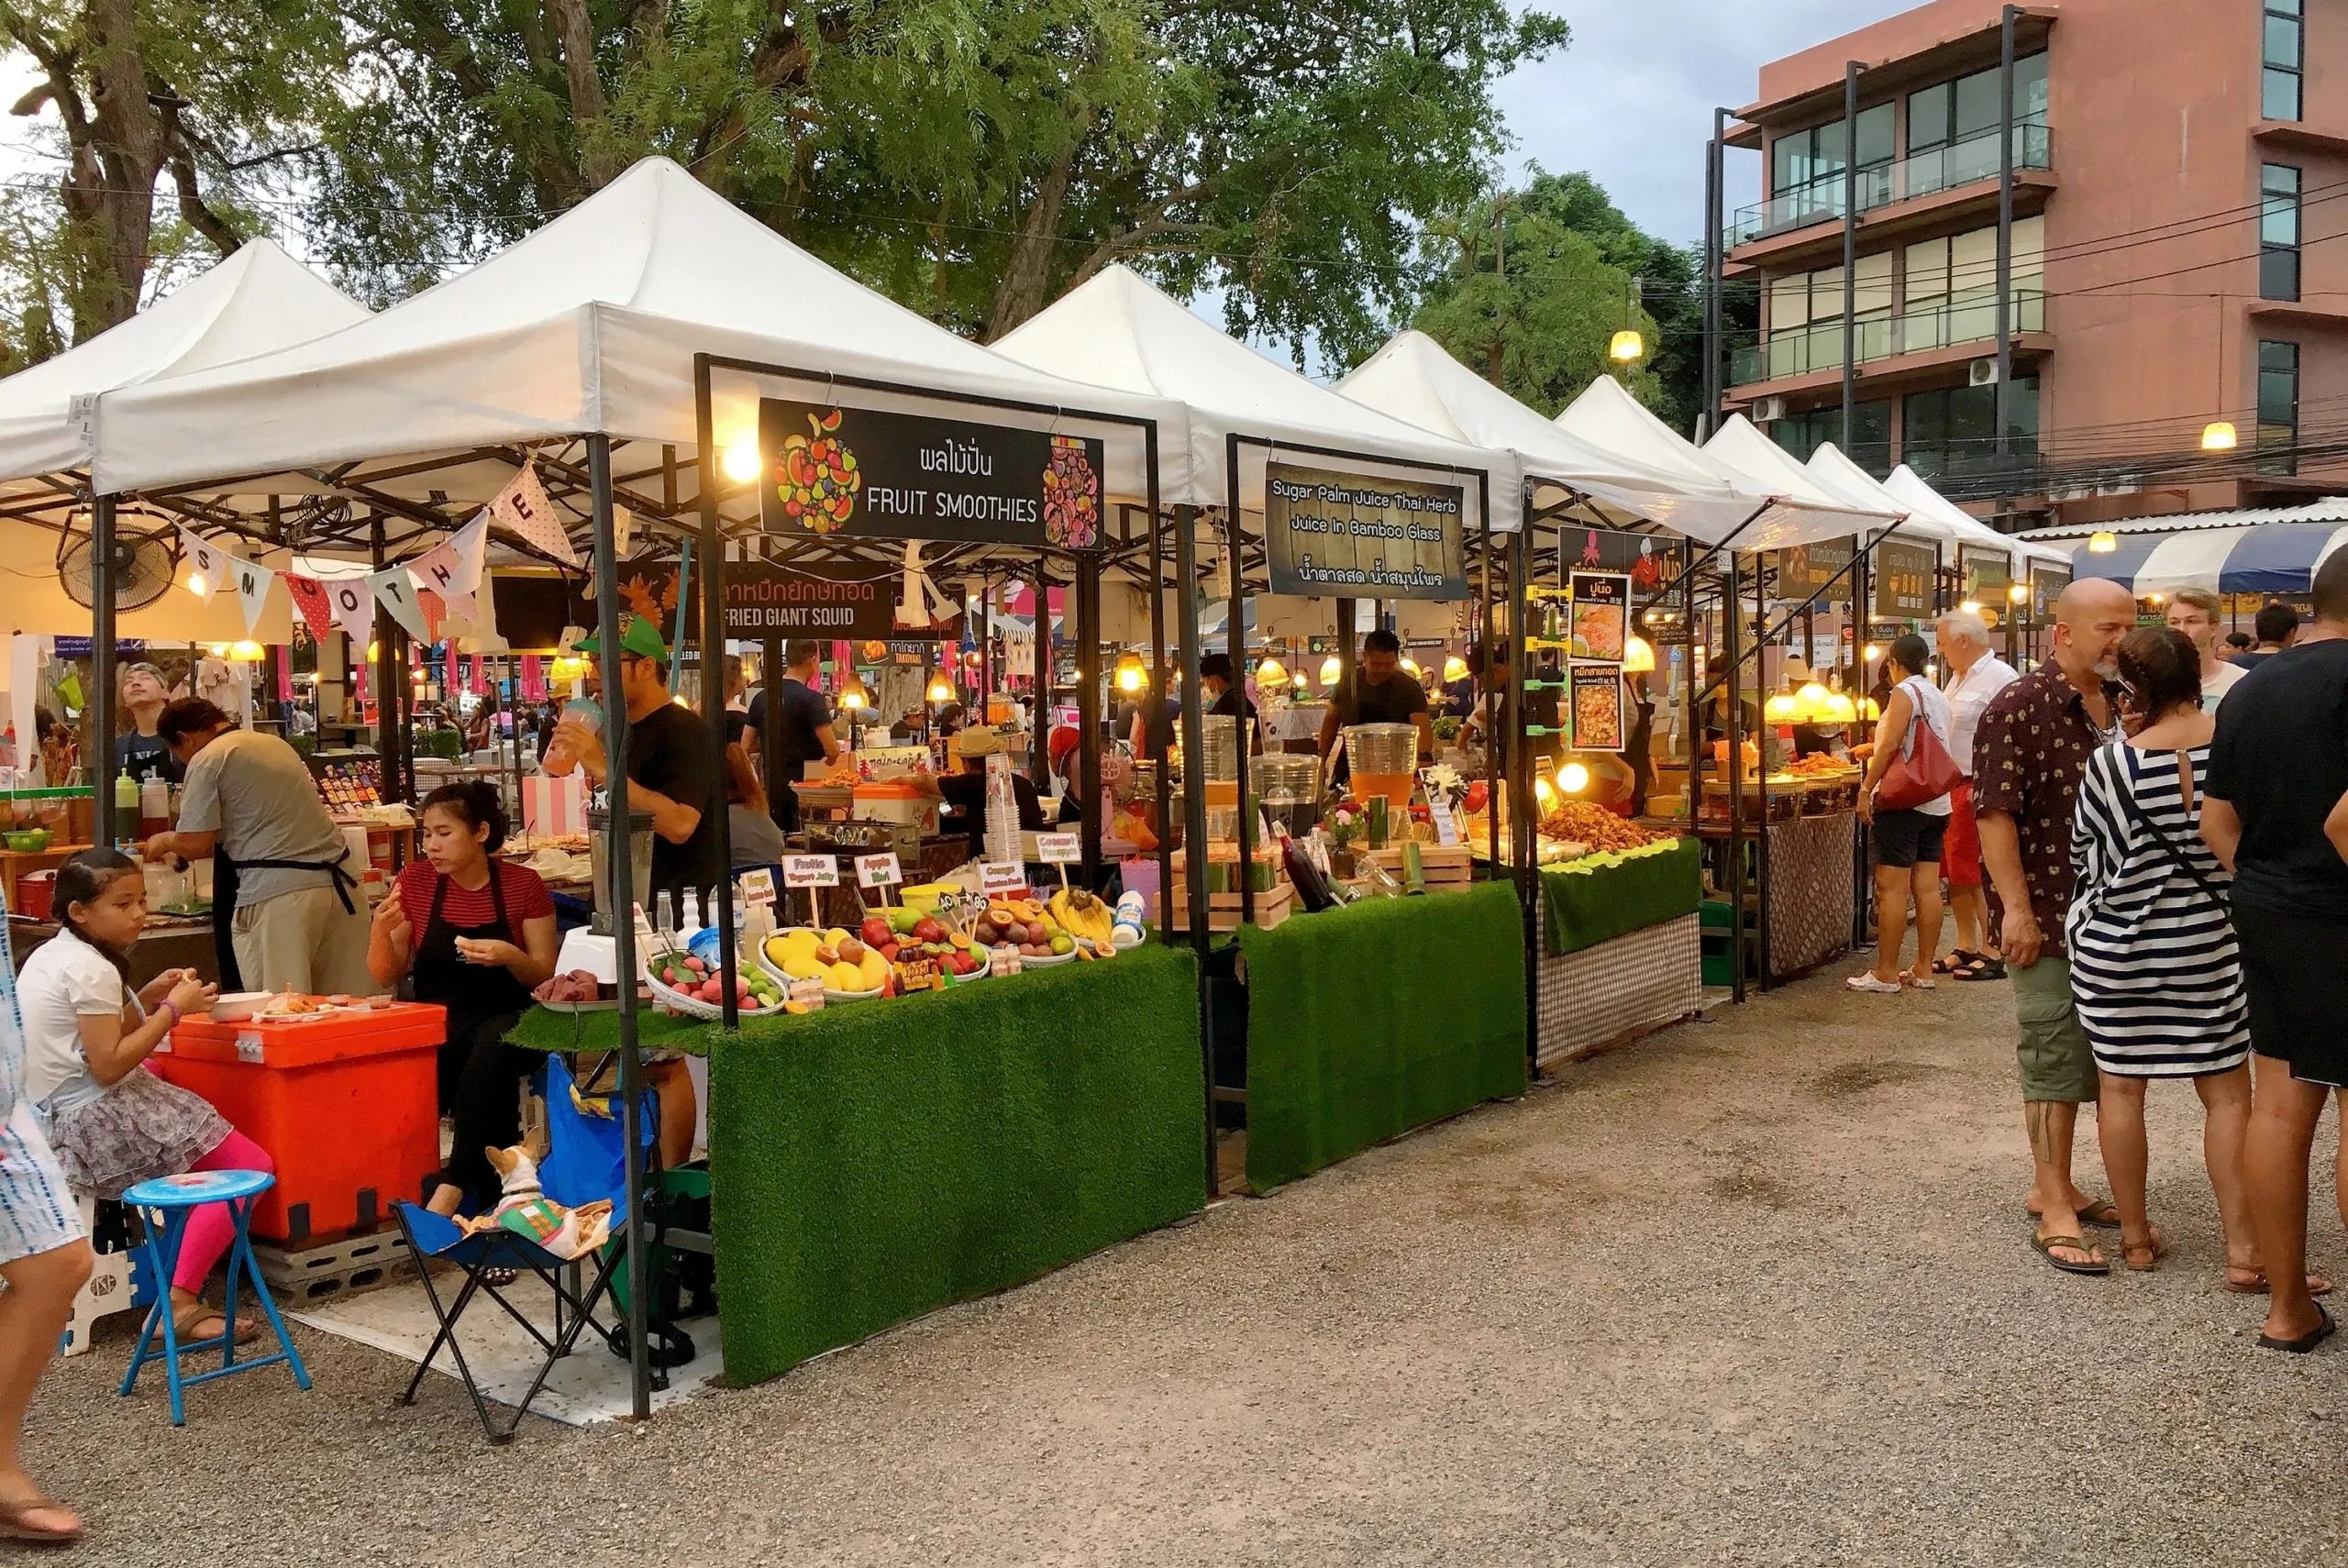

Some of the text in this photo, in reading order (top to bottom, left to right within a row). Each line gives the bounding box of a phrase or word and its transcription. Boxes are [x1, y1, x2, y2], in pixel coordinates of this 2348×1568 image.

[920, 438, 991, 477] ผลไม้ปั่น
[868, 486, 1037, 523] FRUIT SMOOTHIES
[1271, 480, 1456, 513] Sugar Palm Juice Thai Herb
[1291, 514, 1441, 541] Juice In Bamboo Glass
[1299, 554, 1443, 591] น้ำตาลสด น้ำสมุนไพร
[765, 607, 809, 626] GIANT
[811, 607, 855, 626] SQUID
[864, 856, 891, 870] Apple
[940, 895, 953, 910] 40
[974, 895, 987, 911] 80
